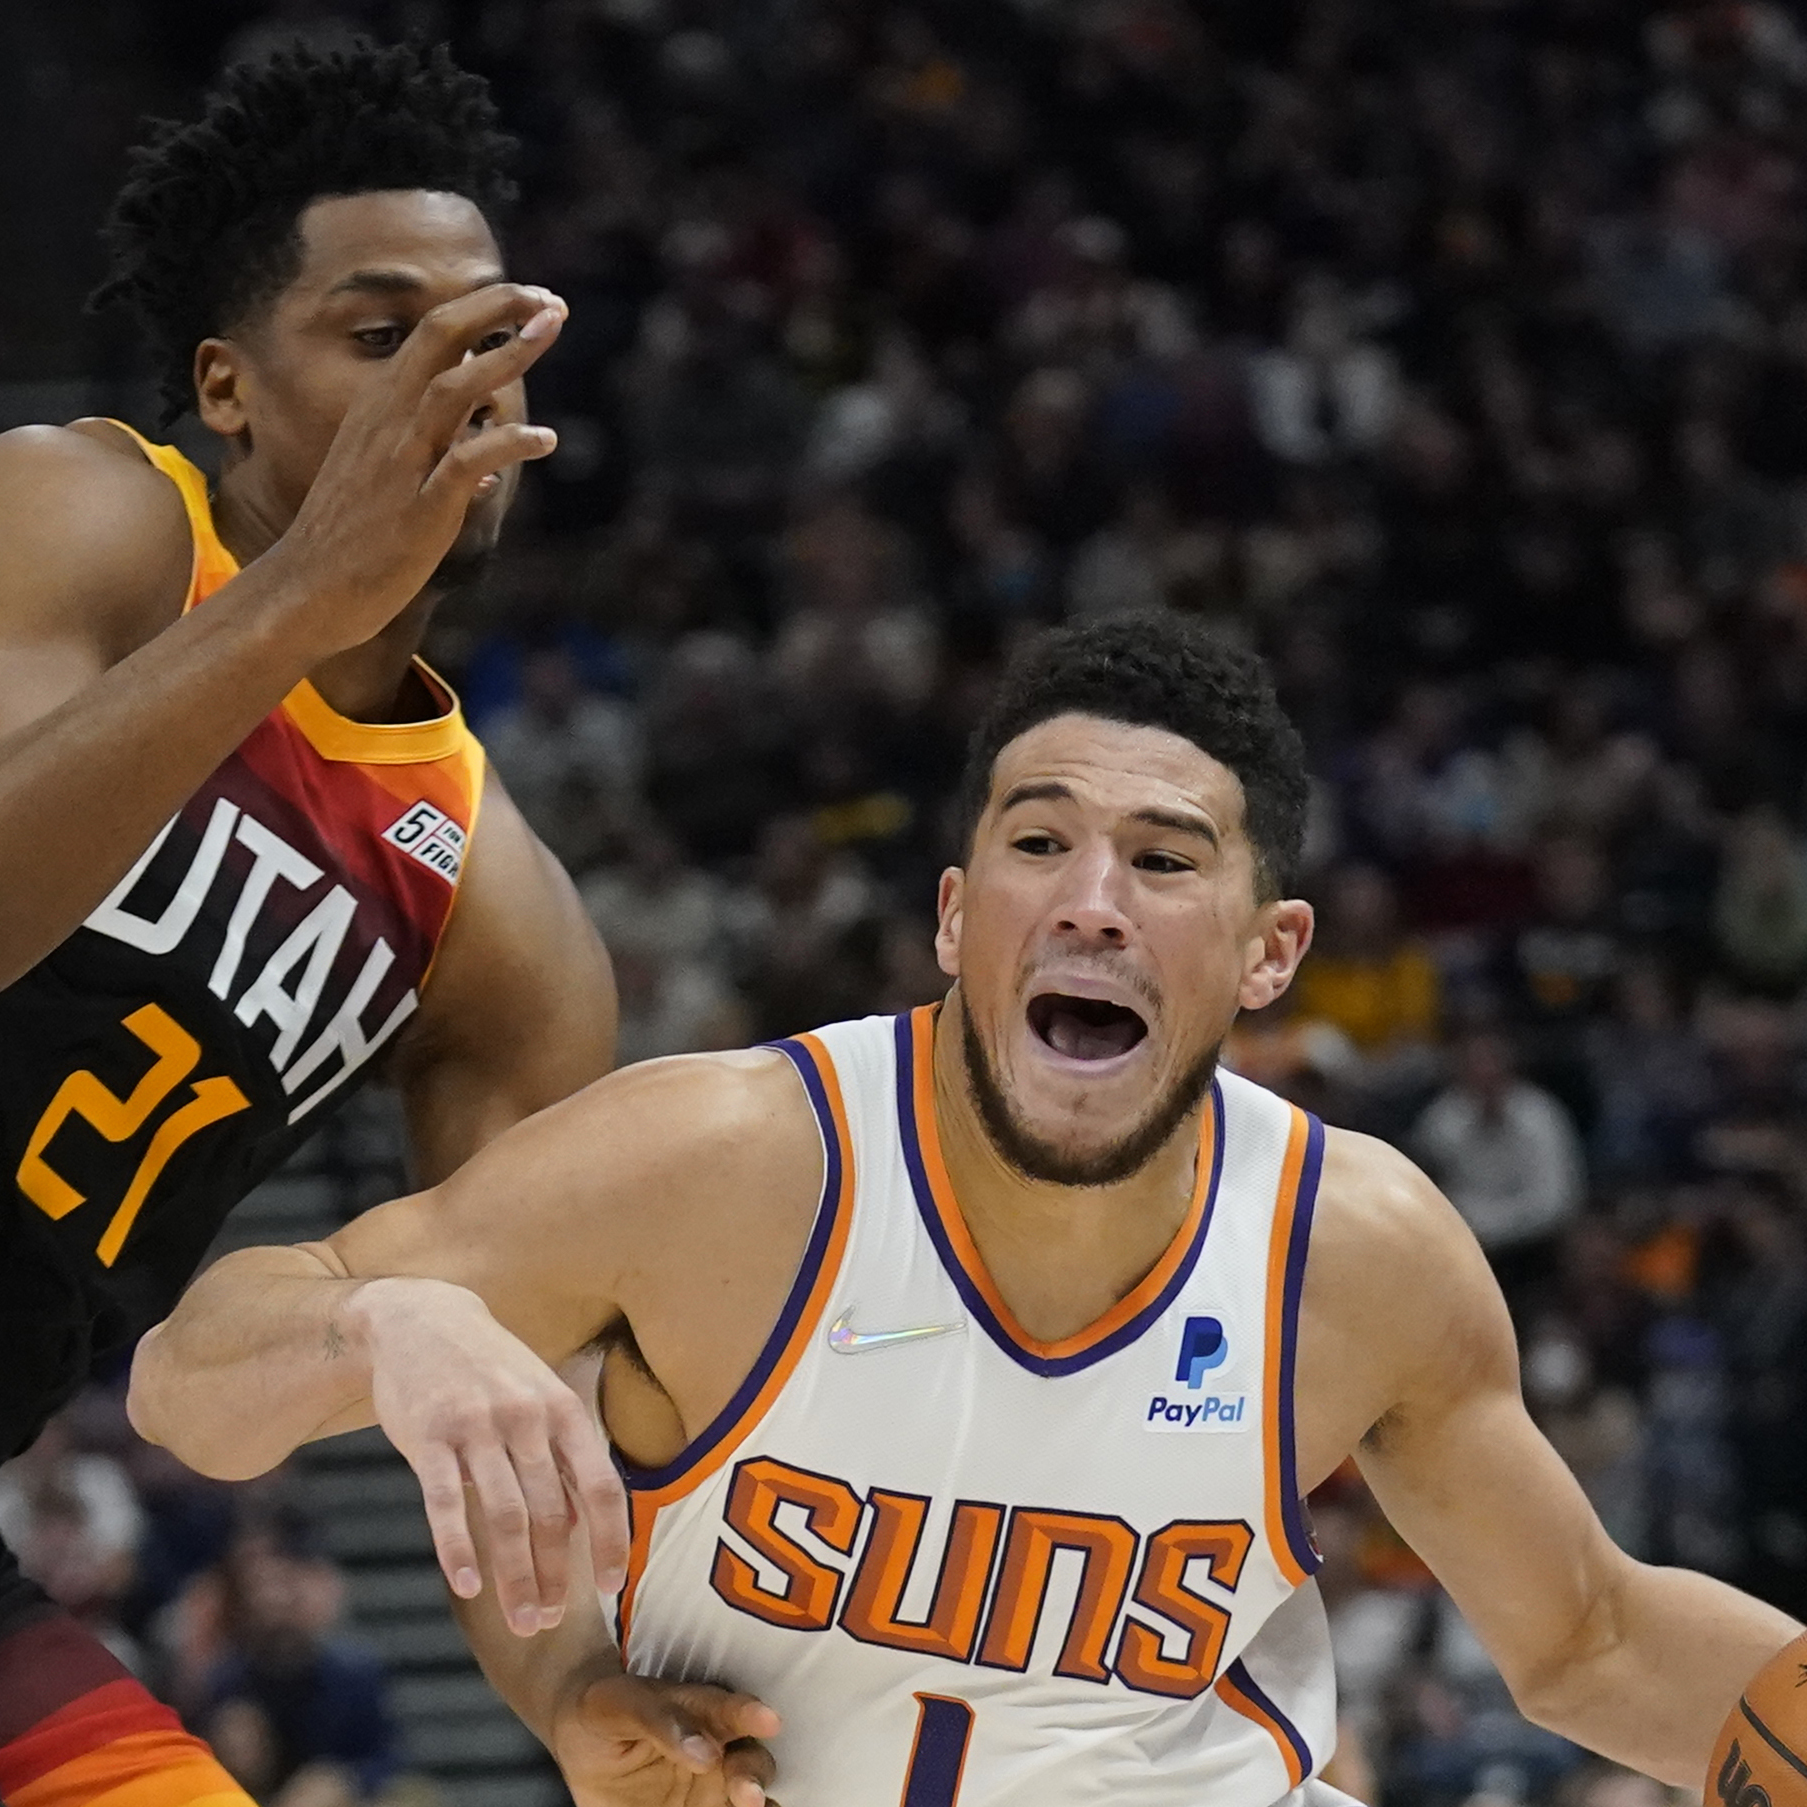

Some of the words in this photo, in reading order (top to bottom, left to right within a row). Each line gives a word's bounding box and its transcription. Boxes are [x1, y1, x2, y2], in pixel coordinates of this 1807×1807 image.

[394, 808, 438, 844] 5
[83, 797, 419, 1126] UTAH
[15, 1001, 253, 1269] 21
[1147, 1396, 1245, 1427] PayPal
